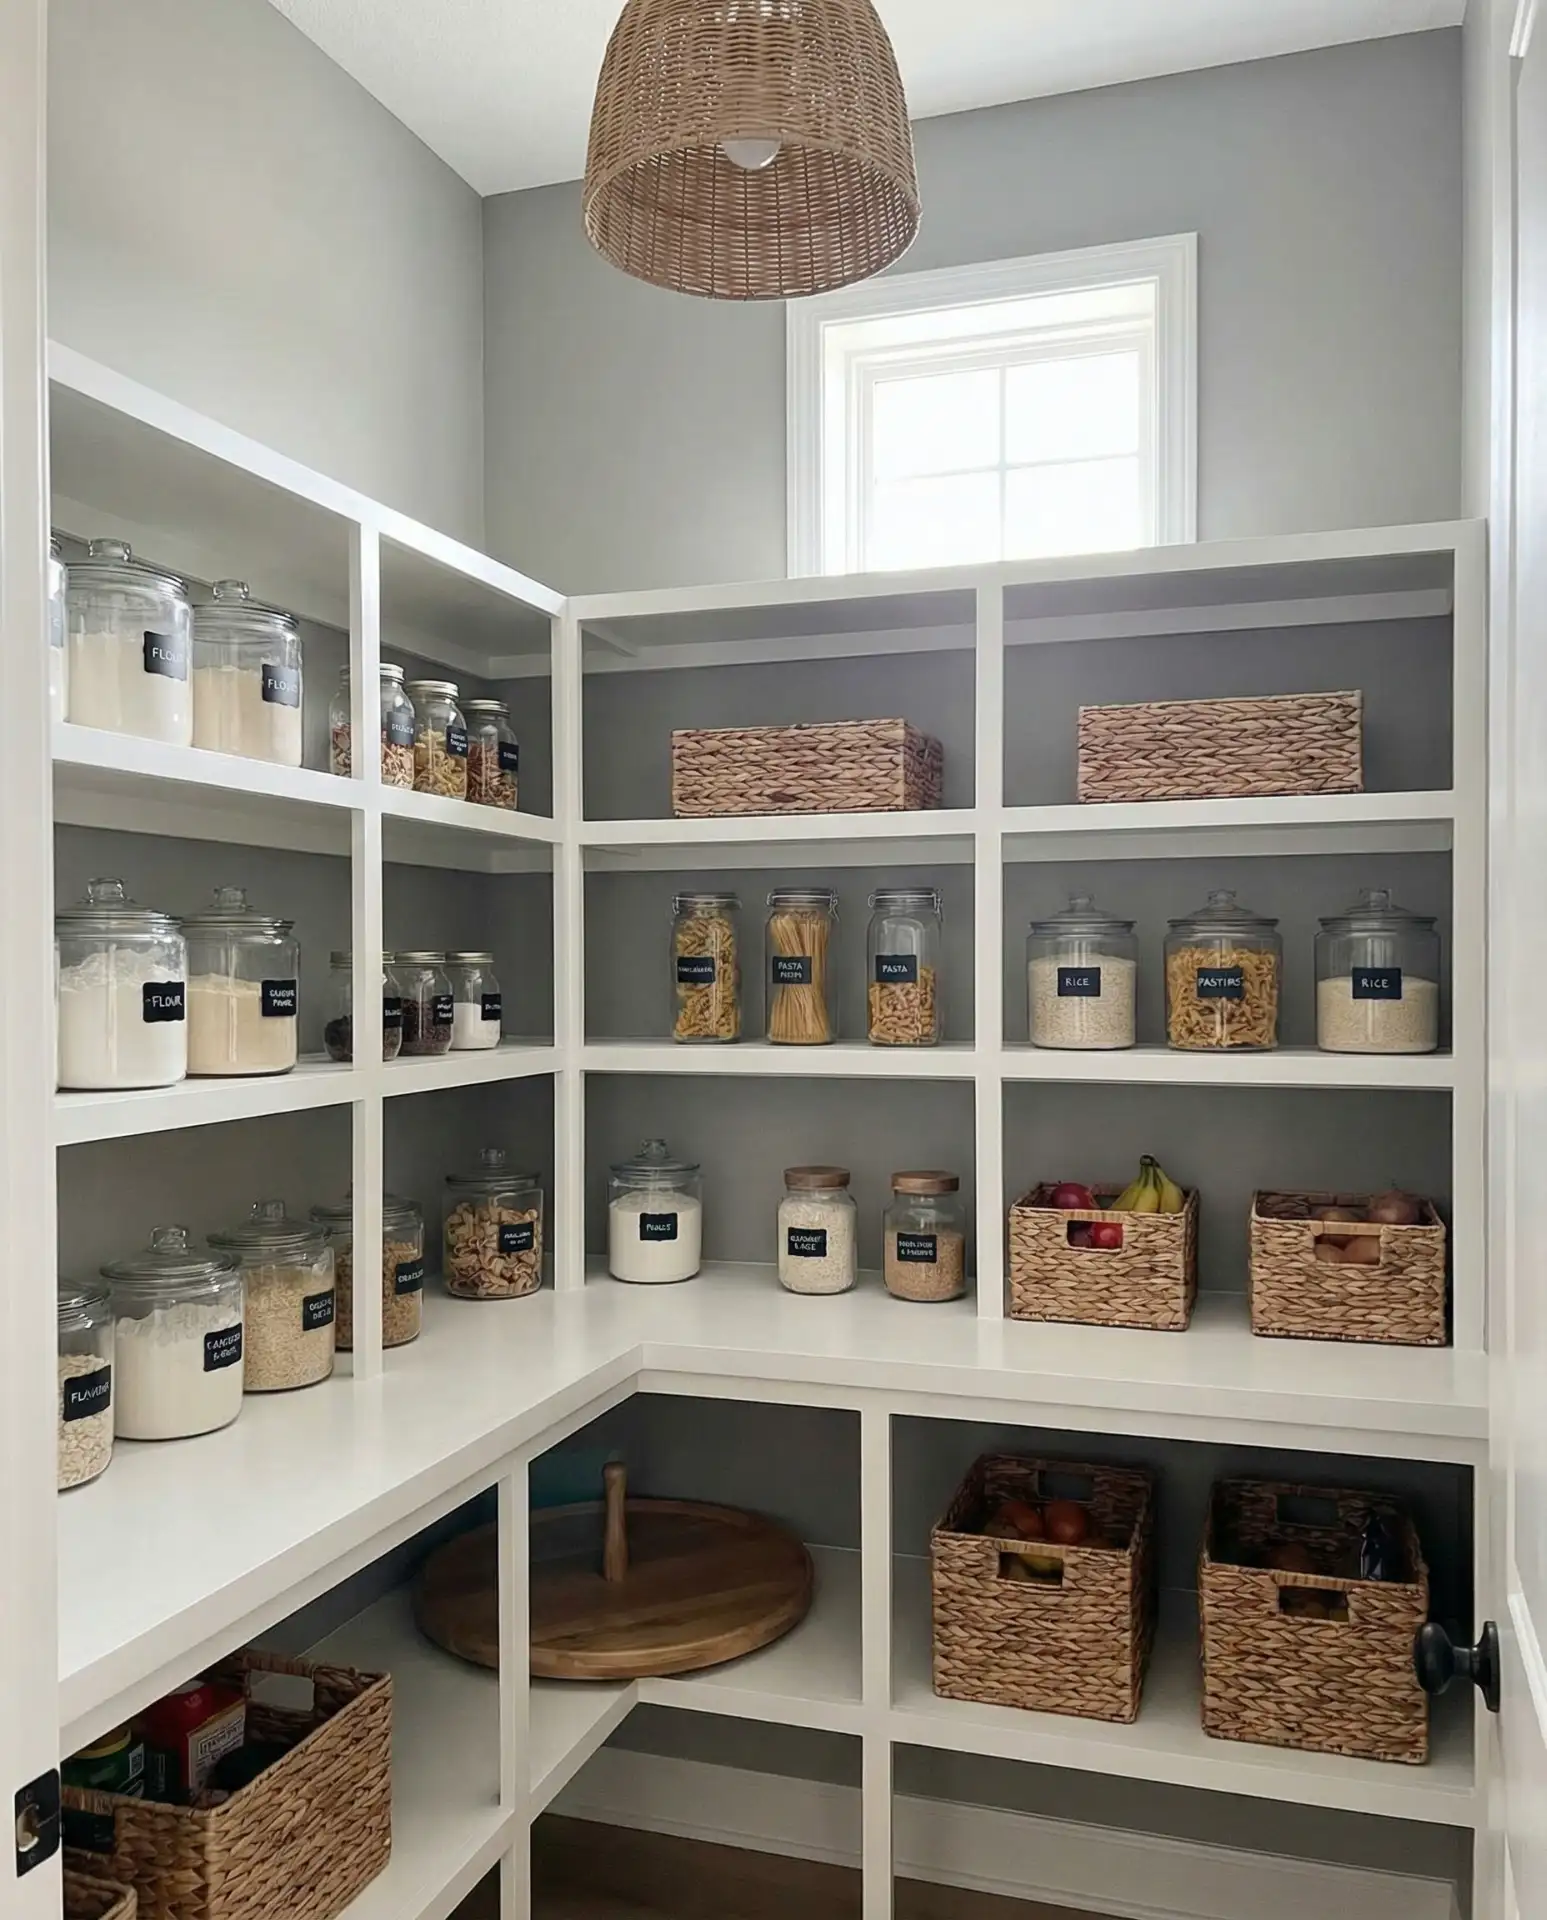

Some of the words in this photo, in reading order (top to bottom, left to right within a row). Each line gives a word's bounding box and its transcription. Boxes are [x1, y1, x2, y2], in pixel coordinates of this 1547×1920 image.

[777, 961, 802, 970] PASTA
[882, 964, 908, 973] PASTA
[1065, 977, 1090, 987] RICE
[1361, 978, 1389, 989] RICE
[152, 995, 182, 1008] FLOUR
